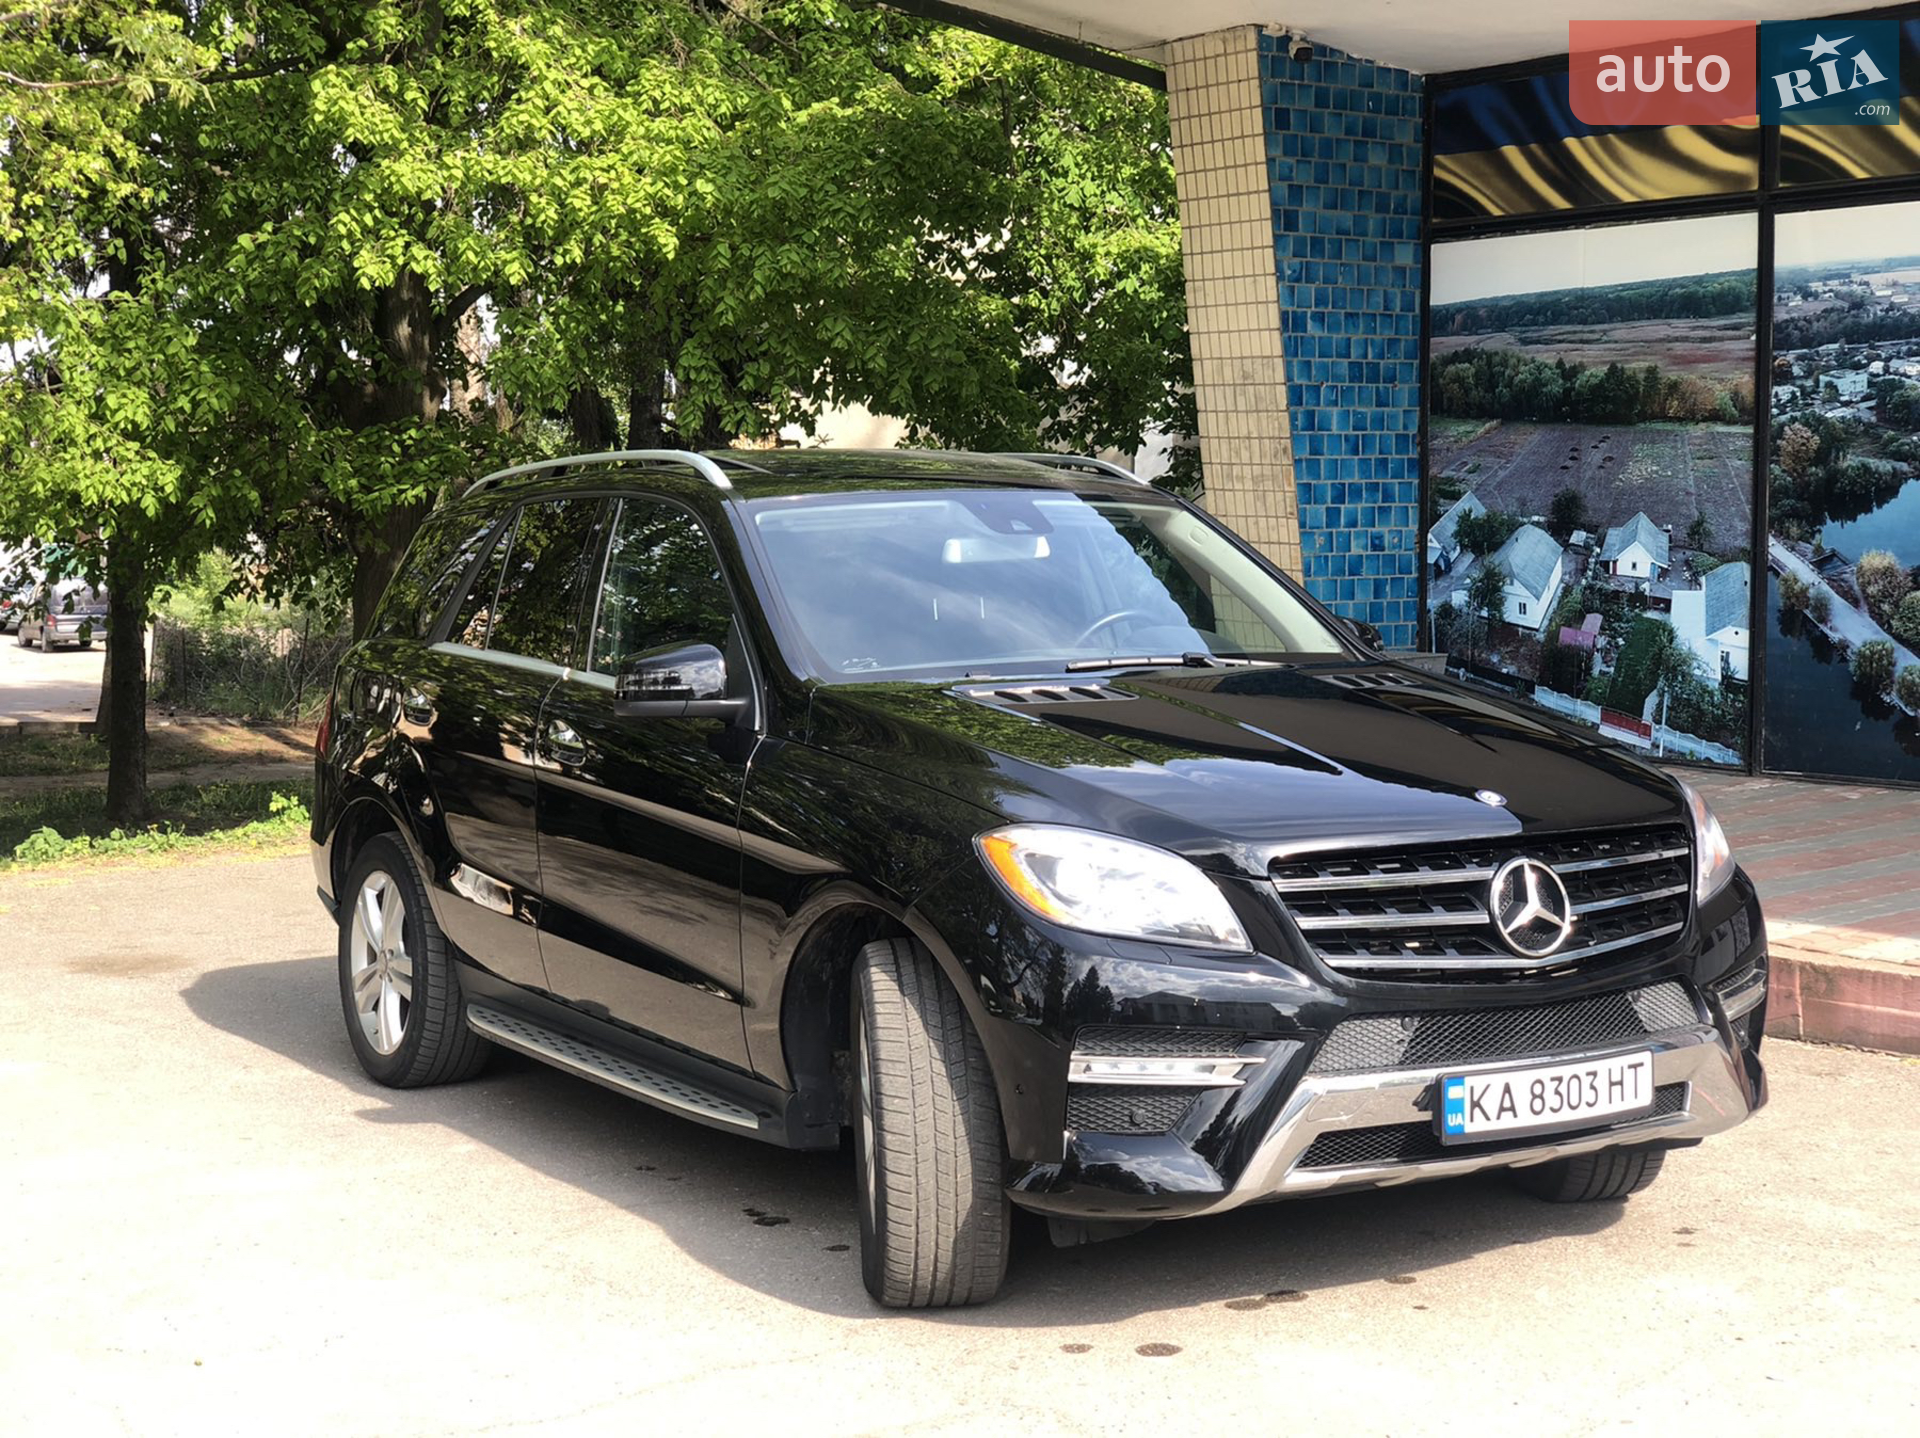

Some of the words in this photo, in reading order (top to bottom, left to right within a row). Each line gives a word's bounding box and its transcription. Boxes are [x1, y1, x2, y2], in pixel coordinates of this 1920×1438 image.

[1469, 1081, 1518, 1123] KA
[1529, 1070, 1599, 1117] 8303
[1607, 1061, 1645, 1105] HT
[1447, 1112, 1465, 1127] UA
